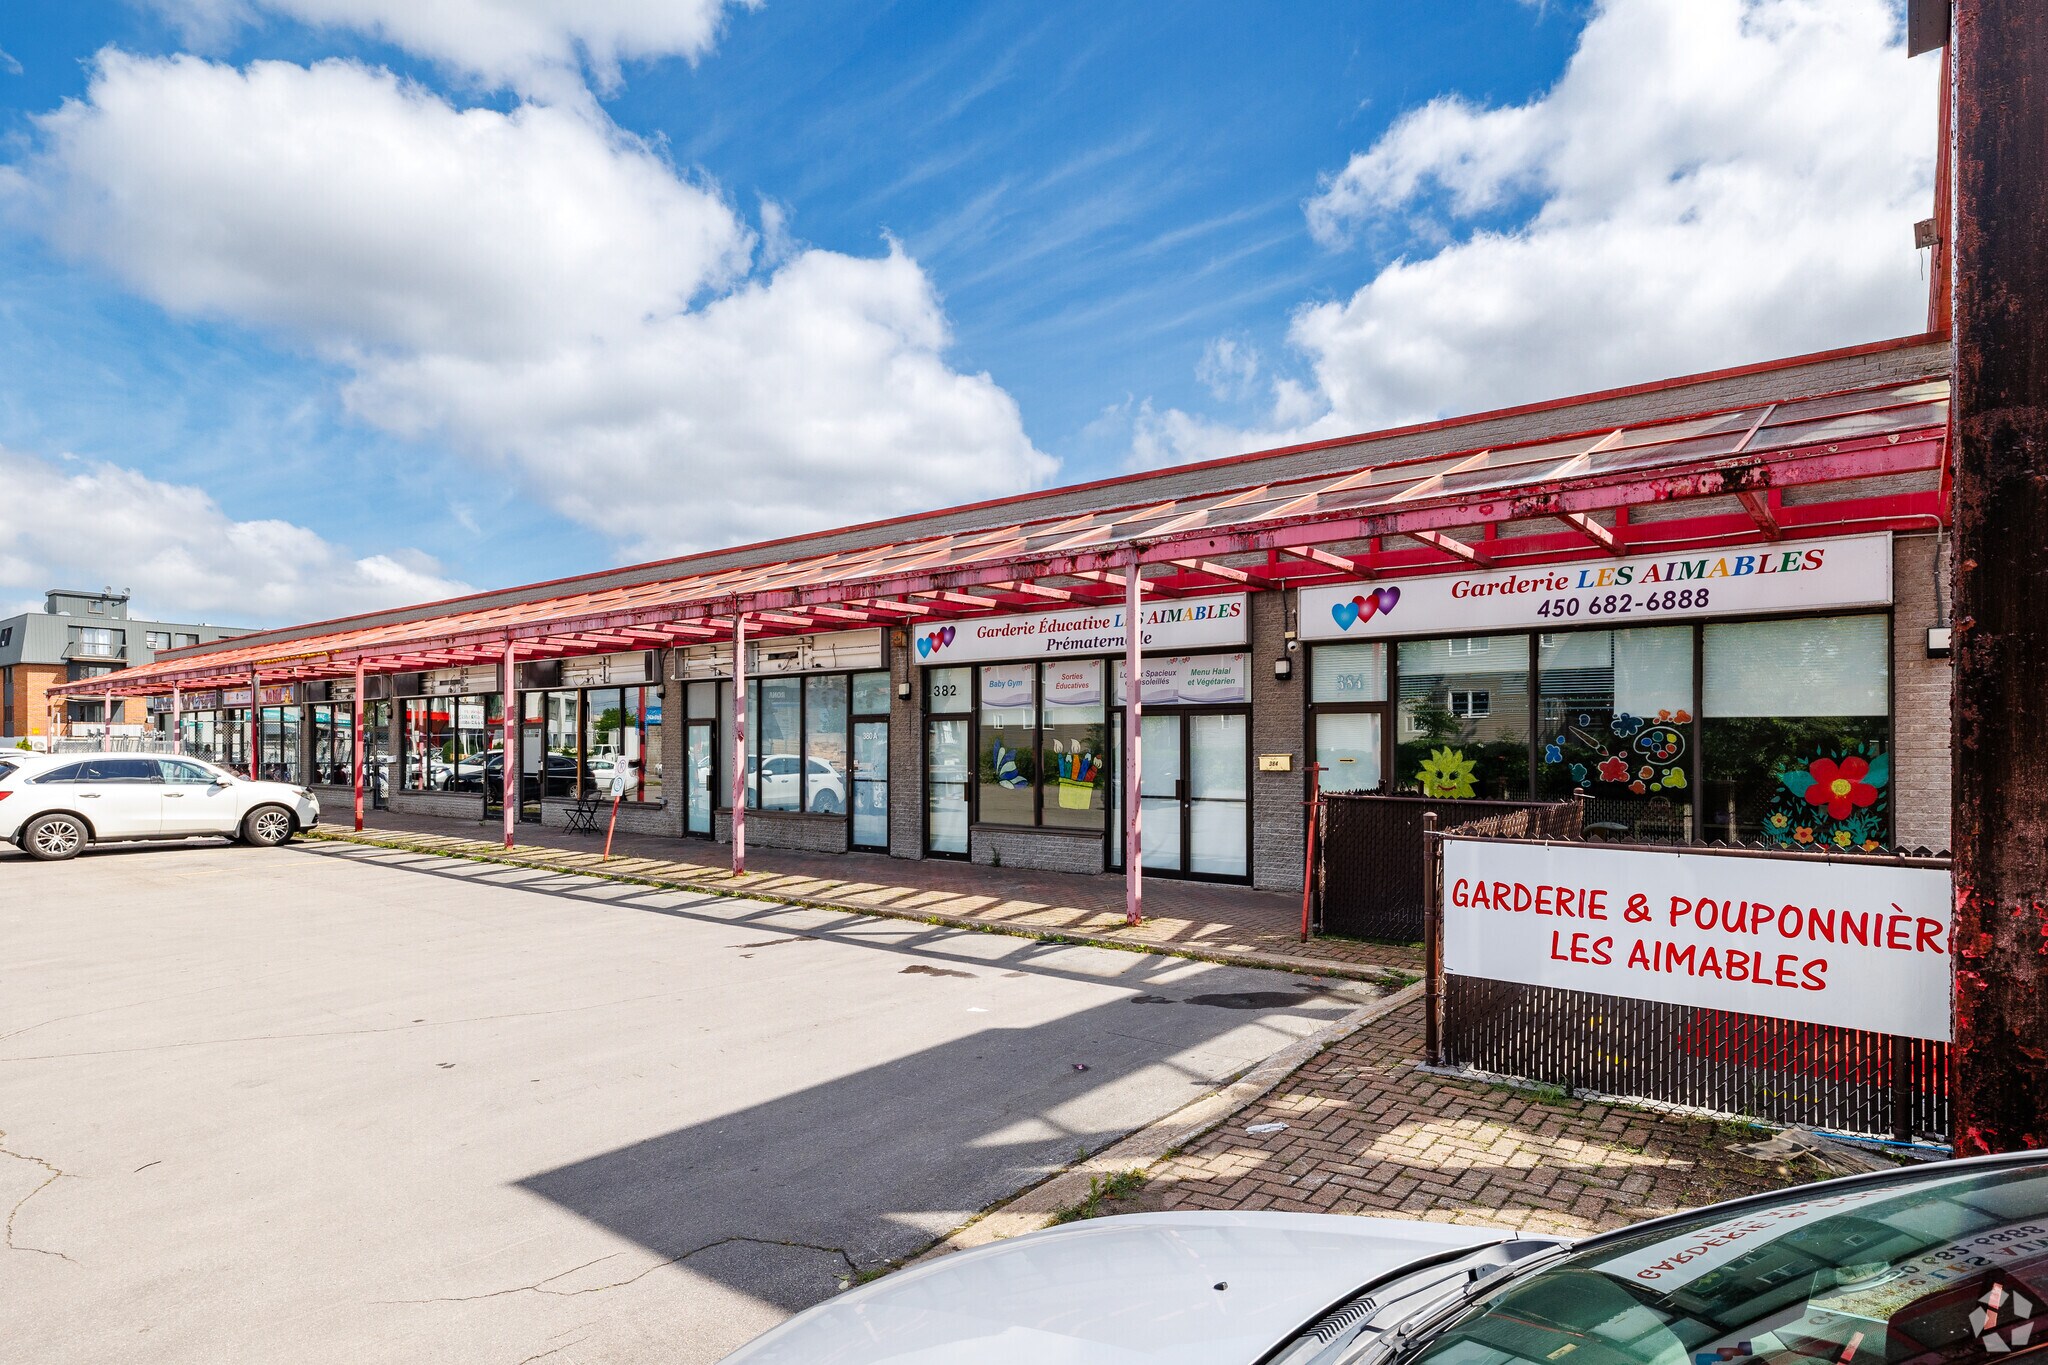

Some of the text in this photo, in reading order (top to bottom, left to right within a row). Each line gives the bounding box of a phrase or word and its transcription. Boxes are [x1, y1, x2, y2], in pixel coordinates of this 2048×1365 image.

[1451, 548, 1825, 599] Garderie LES AIMABLES
[1537, 588, 1710, 618] 450 682-6888
[977, 623, 1035, 639] Garderie
[1038, 616, 1110, 635] Éducative
[1147, 602, 1242, 625] AIMABLES
[1046, 631, 1152, 652] Prématernle
[1145, 669, 1177, 679] Spacieux
[1187, 677, 1236, 687] et Végétarien
[1190, 667, 1231, 676] Menu Halal
[933, 684, 957, 697] 382
[989, 679, 1023, 689] Baby Gym
[1452, 877, 1952, 956] GARDERIE & POUPONNIÈR
[1550, 930, 1829, 992] LES AIMABLES
